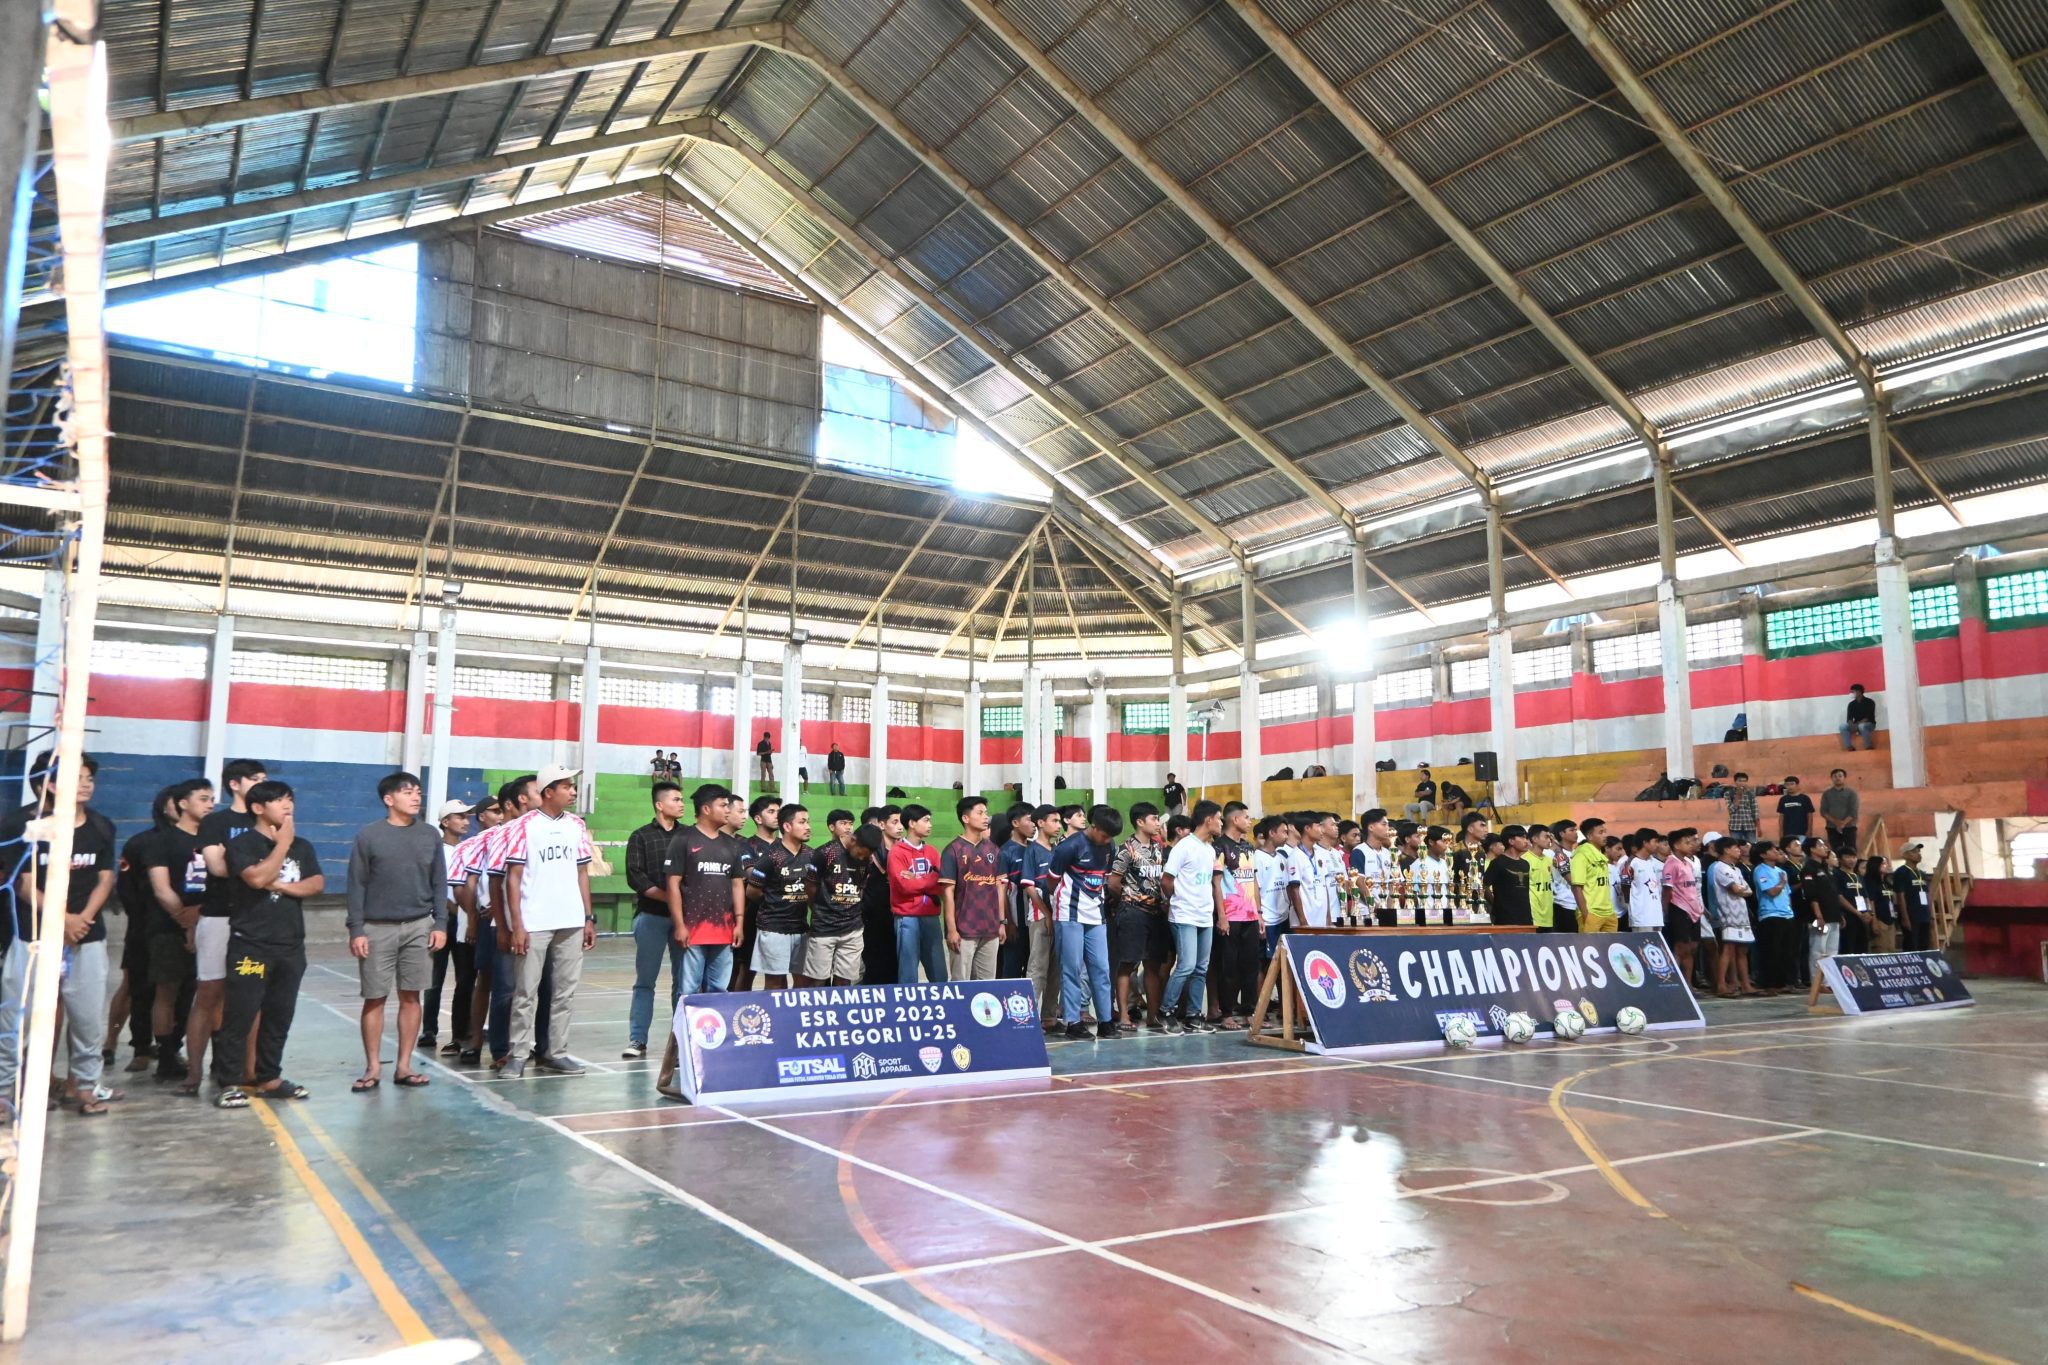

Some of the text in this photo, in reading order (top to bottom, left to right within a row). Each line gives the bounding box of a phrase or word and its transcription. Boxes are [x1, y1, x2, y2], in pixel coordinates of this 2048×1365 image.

[833, 864, 841, 873] 21
[1859, 954, 1923, 966] TURNAMEN FUTSAL
[1398, 945, 1608, 998] CHAMPIONS
[1873, 967, 1890, 977] ESR
[1889, 966, 1903, 976] CUP
[1878, 975, 1932, 988] KATEGORI U-25
[771, 985, 965, 1008] TURNAMEN FUTSAL
[800, 1005, 946, 1028] ESR CUP 2023
[795, 1024, 957, 1049] KATEGORI U-25
[778, 1057, 846, 1077] FUTSAL
[878, 1057, 902, 1065] SPORT
[880, 1065, 912, 1074] APPAREL
